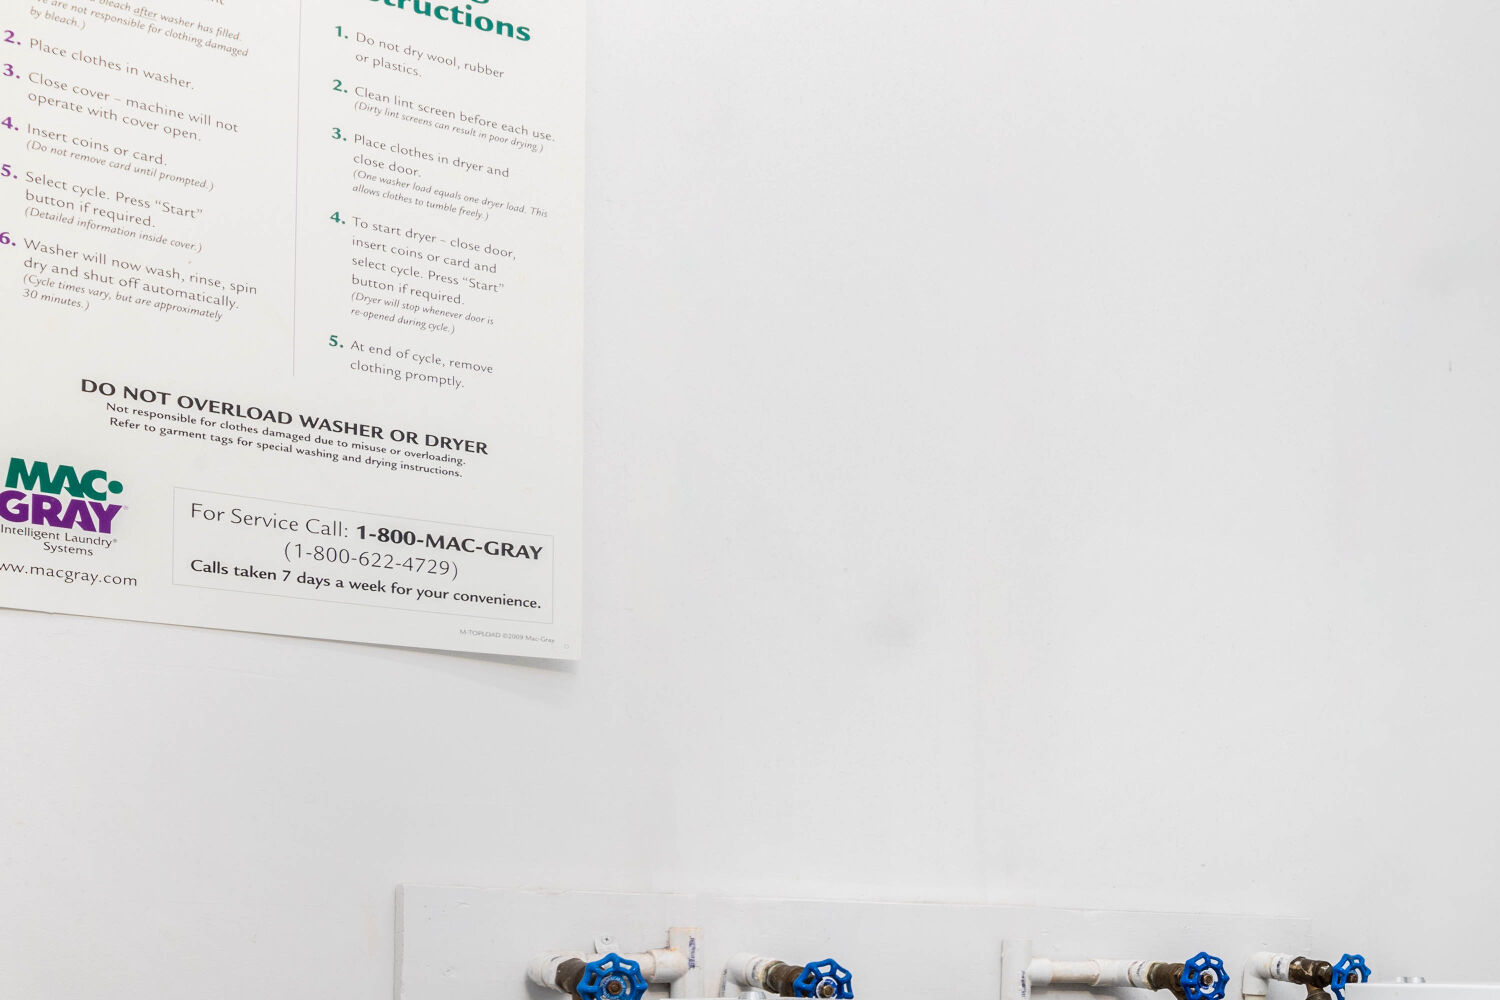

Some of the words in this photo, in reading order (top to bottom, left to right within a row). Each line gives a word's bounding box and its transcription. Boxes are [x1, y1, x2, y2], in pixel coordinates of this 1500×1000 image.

[3, 29, 22, 46] 2.
[30, 38, 67, 57] Place
[71, 50, 122, 71] clothes
[126, 63, 138, 76] in
[143, 70, 194, 90] washer.
[335, 25, 349, 40] 1.
[356, 31, 375, 46] Do
[379, 41, 400, 53] not
[403, 45, 424, 61] dry
[426, 53, 460, 70] wool,
[464, 62, 505, 78] rubber
[355, 54, 369, 63] or
[372, 56, 422, 78] plastics.
[332, 78, 348, 94] 2.
[354, 86, 390, 104] Clean
[394, 95, 414, 110] lint
[418, 104, 456, 119] screen
[459, 111, 498, 129] before
[501, 123, 529, 136] each
[532, 131, 556, 142] use.
[0, 163, 18, 180] 5.
[25, 171, 67, 191] Select
[72, 185, 110, 200] cycle.
[116, 191, 151, 209] Press
[25, 188, 74, 210] button
[80, 201, 91, 213] if
[93, 207, 155, 228] required.
[0, 231, 17, 247] 6.
[23, 238, 79, 259] Washer
[82, 253, 106, 265] will
[111, 259, 142, 272] now
[145, 266, 185, 282] wash,
[189, 275, 225, 290] rinse,
[230, 282, 257, 295] spin
[23, 257, 48, 274] dry
[51, 265, 79, 278] and
[83, 269, 114, 285] shut
[118, 276, 141, 289] off
[142, 283, 239, 311] automatically.
[328, 334, 344, 349] 5.
[350, 340, 365, 352] At
[368, 346, 392, 357] end
[395, 349, 410, 359] of
[412, 353, 446, 368] cycle,
[449, 360, 493, 374] remove
[350, 359, 402, 381] clothing
[405, 371, 464, 390] promptly.
[81, 378, 116, 397] DO
[123, 385, 172, 405] NOT
[177, 395, 293, 425] OVERLOAD
[298, 414, 384, 440] WASHER
[389, 429, 419, 445] OR
[425, 434, 488, 455] DRYER
[106, 402, 129, 414] Not
[132, 409, 197, 425] responsible
[200, 416, 217, 427] for
[219, 420, 259, 434] clothes
[262, 426, 311, 443] damaged
[314, 435, 334, 446] due
[337, 440, 349, 448] to
[351, 441, 387, 454] misuse
[404, 450, 466, 467] overloading.
[110, 417, 141, 430] Refer
[144, 424, 156, 432] to
[159, 427, 206, 440] garment
[210, 434, 234, 446] tags
[237, 436, 254, 447] for
[256, 442, 293, 453] special
[295, 448, 339, 463] washing
[342, 454, 362, 463] and
[364, 456, 398, 471] drying
[400, 460, 463, 478] instructions.
[0, 490, 123, 533] GRAY
[0, 523, 60, 541] Intelligent
[191, 502, 225, 521] For
[230, 508, 299, 532] Service
[305, 518, 348, 538] Call:
[356, 525, 543, 560] 1-800-MAC-GRAY
[43, 541, 94, 556] Systems
[284, 541, 458, 581] (1-800-622-4729)
[0, 563, 137, 587] ww.macgray.com
[190, 559, 229, 575] Calls
[233, 565, 277, 581] taken
[282, 569, 291, 582] 7
[296, 571, 331, 590] days
[335, 579, 344, 588] a
[348, 579, 386, 593] week
[390, 581, 413, 595] for
[416, 588, 450, 601] your
[453, 592, 541, 609] convenience.
